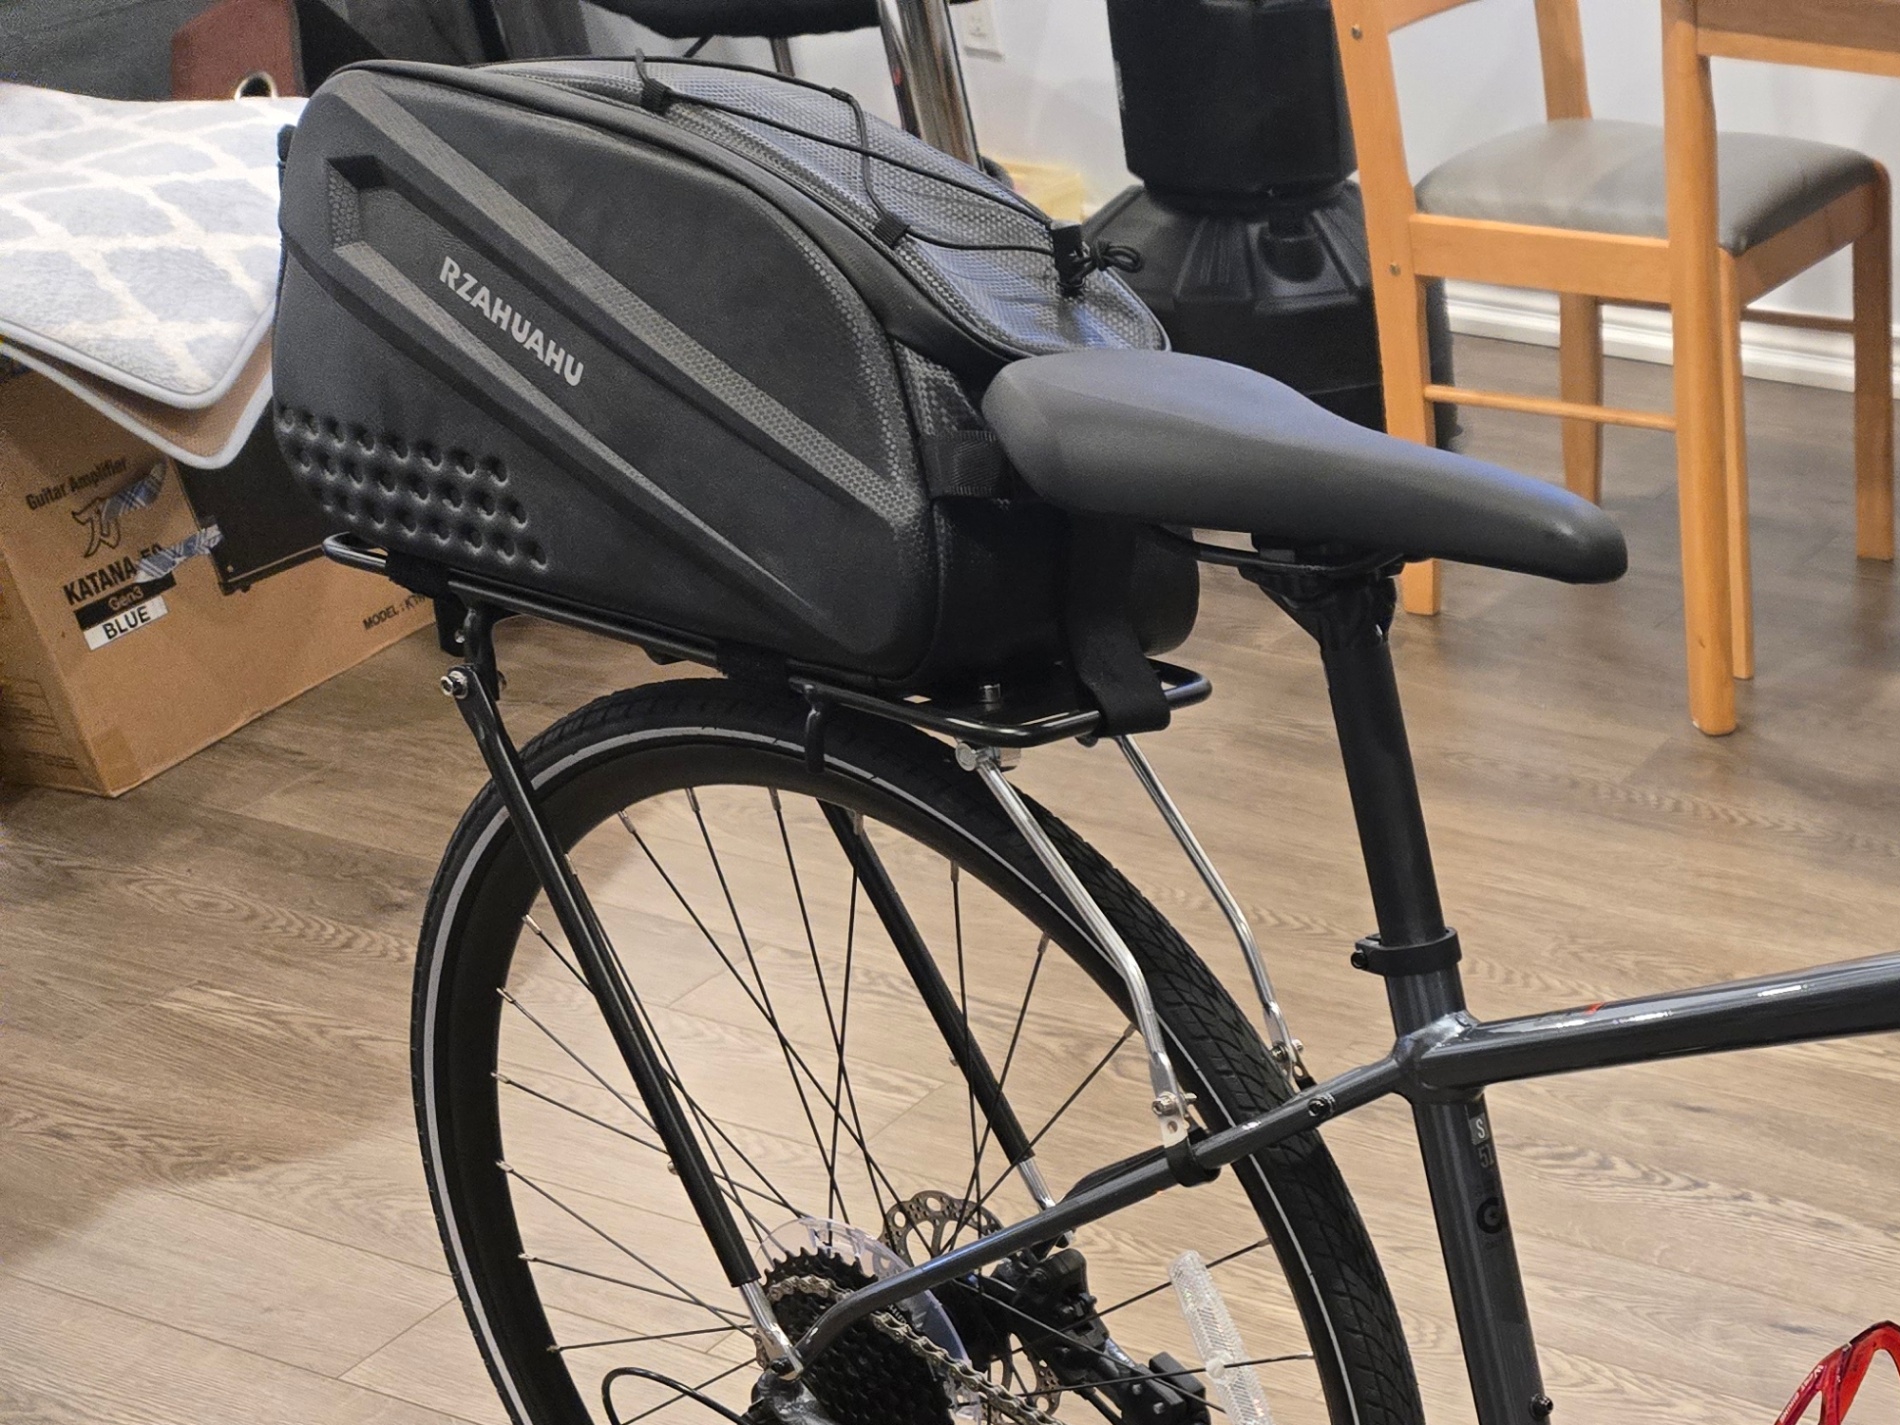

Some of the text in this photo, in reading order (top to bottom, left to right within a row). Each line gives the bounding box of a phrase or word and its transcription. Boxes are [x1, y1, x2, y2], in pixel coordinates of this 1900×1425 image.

[439, 255, 584, 388] RZAHUAHU
[25, 457, 128, 511] Guitar Amplifier
[107, 586, 144, 611] Gen3
[102, 604, 152, 640] BLUE
[362, 604, 399, 630] MODEL
[1475, 1117, 1487, 1139] S
